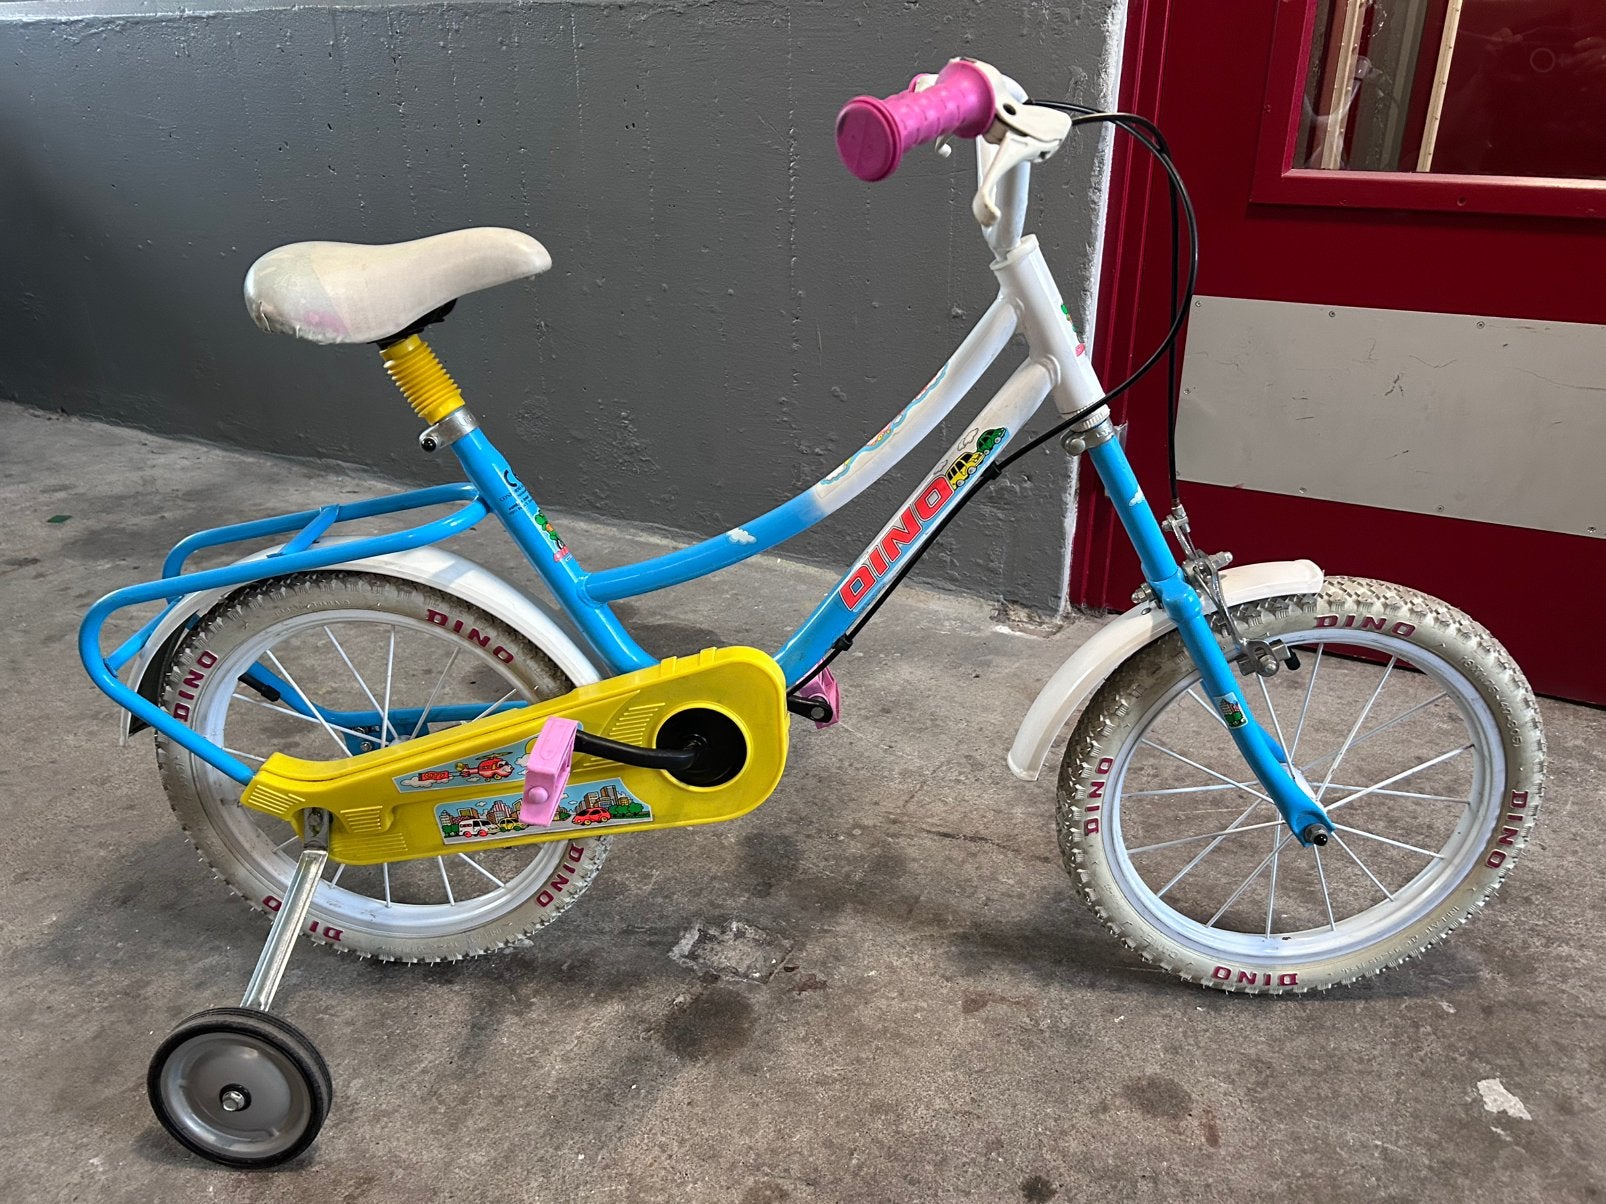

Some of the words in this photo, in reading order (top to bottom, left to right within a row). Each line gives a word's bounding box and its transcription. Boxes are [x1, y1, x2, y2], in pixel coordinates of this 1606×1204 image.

[838, 475, 955, 611] DINO
[426, 608, 515, 664] DINO
[1314, 613, 1416, 638] DINO
[172, 649, 219, 722] DINO
[1083, 755, 1114, 837] DINO
[1485, 788, 1529, 869] DINO
[535, 842, 585, 908] DINO
[262, 895, 344, 942] DIO
[1210, 965, 1299, 987] DINO
